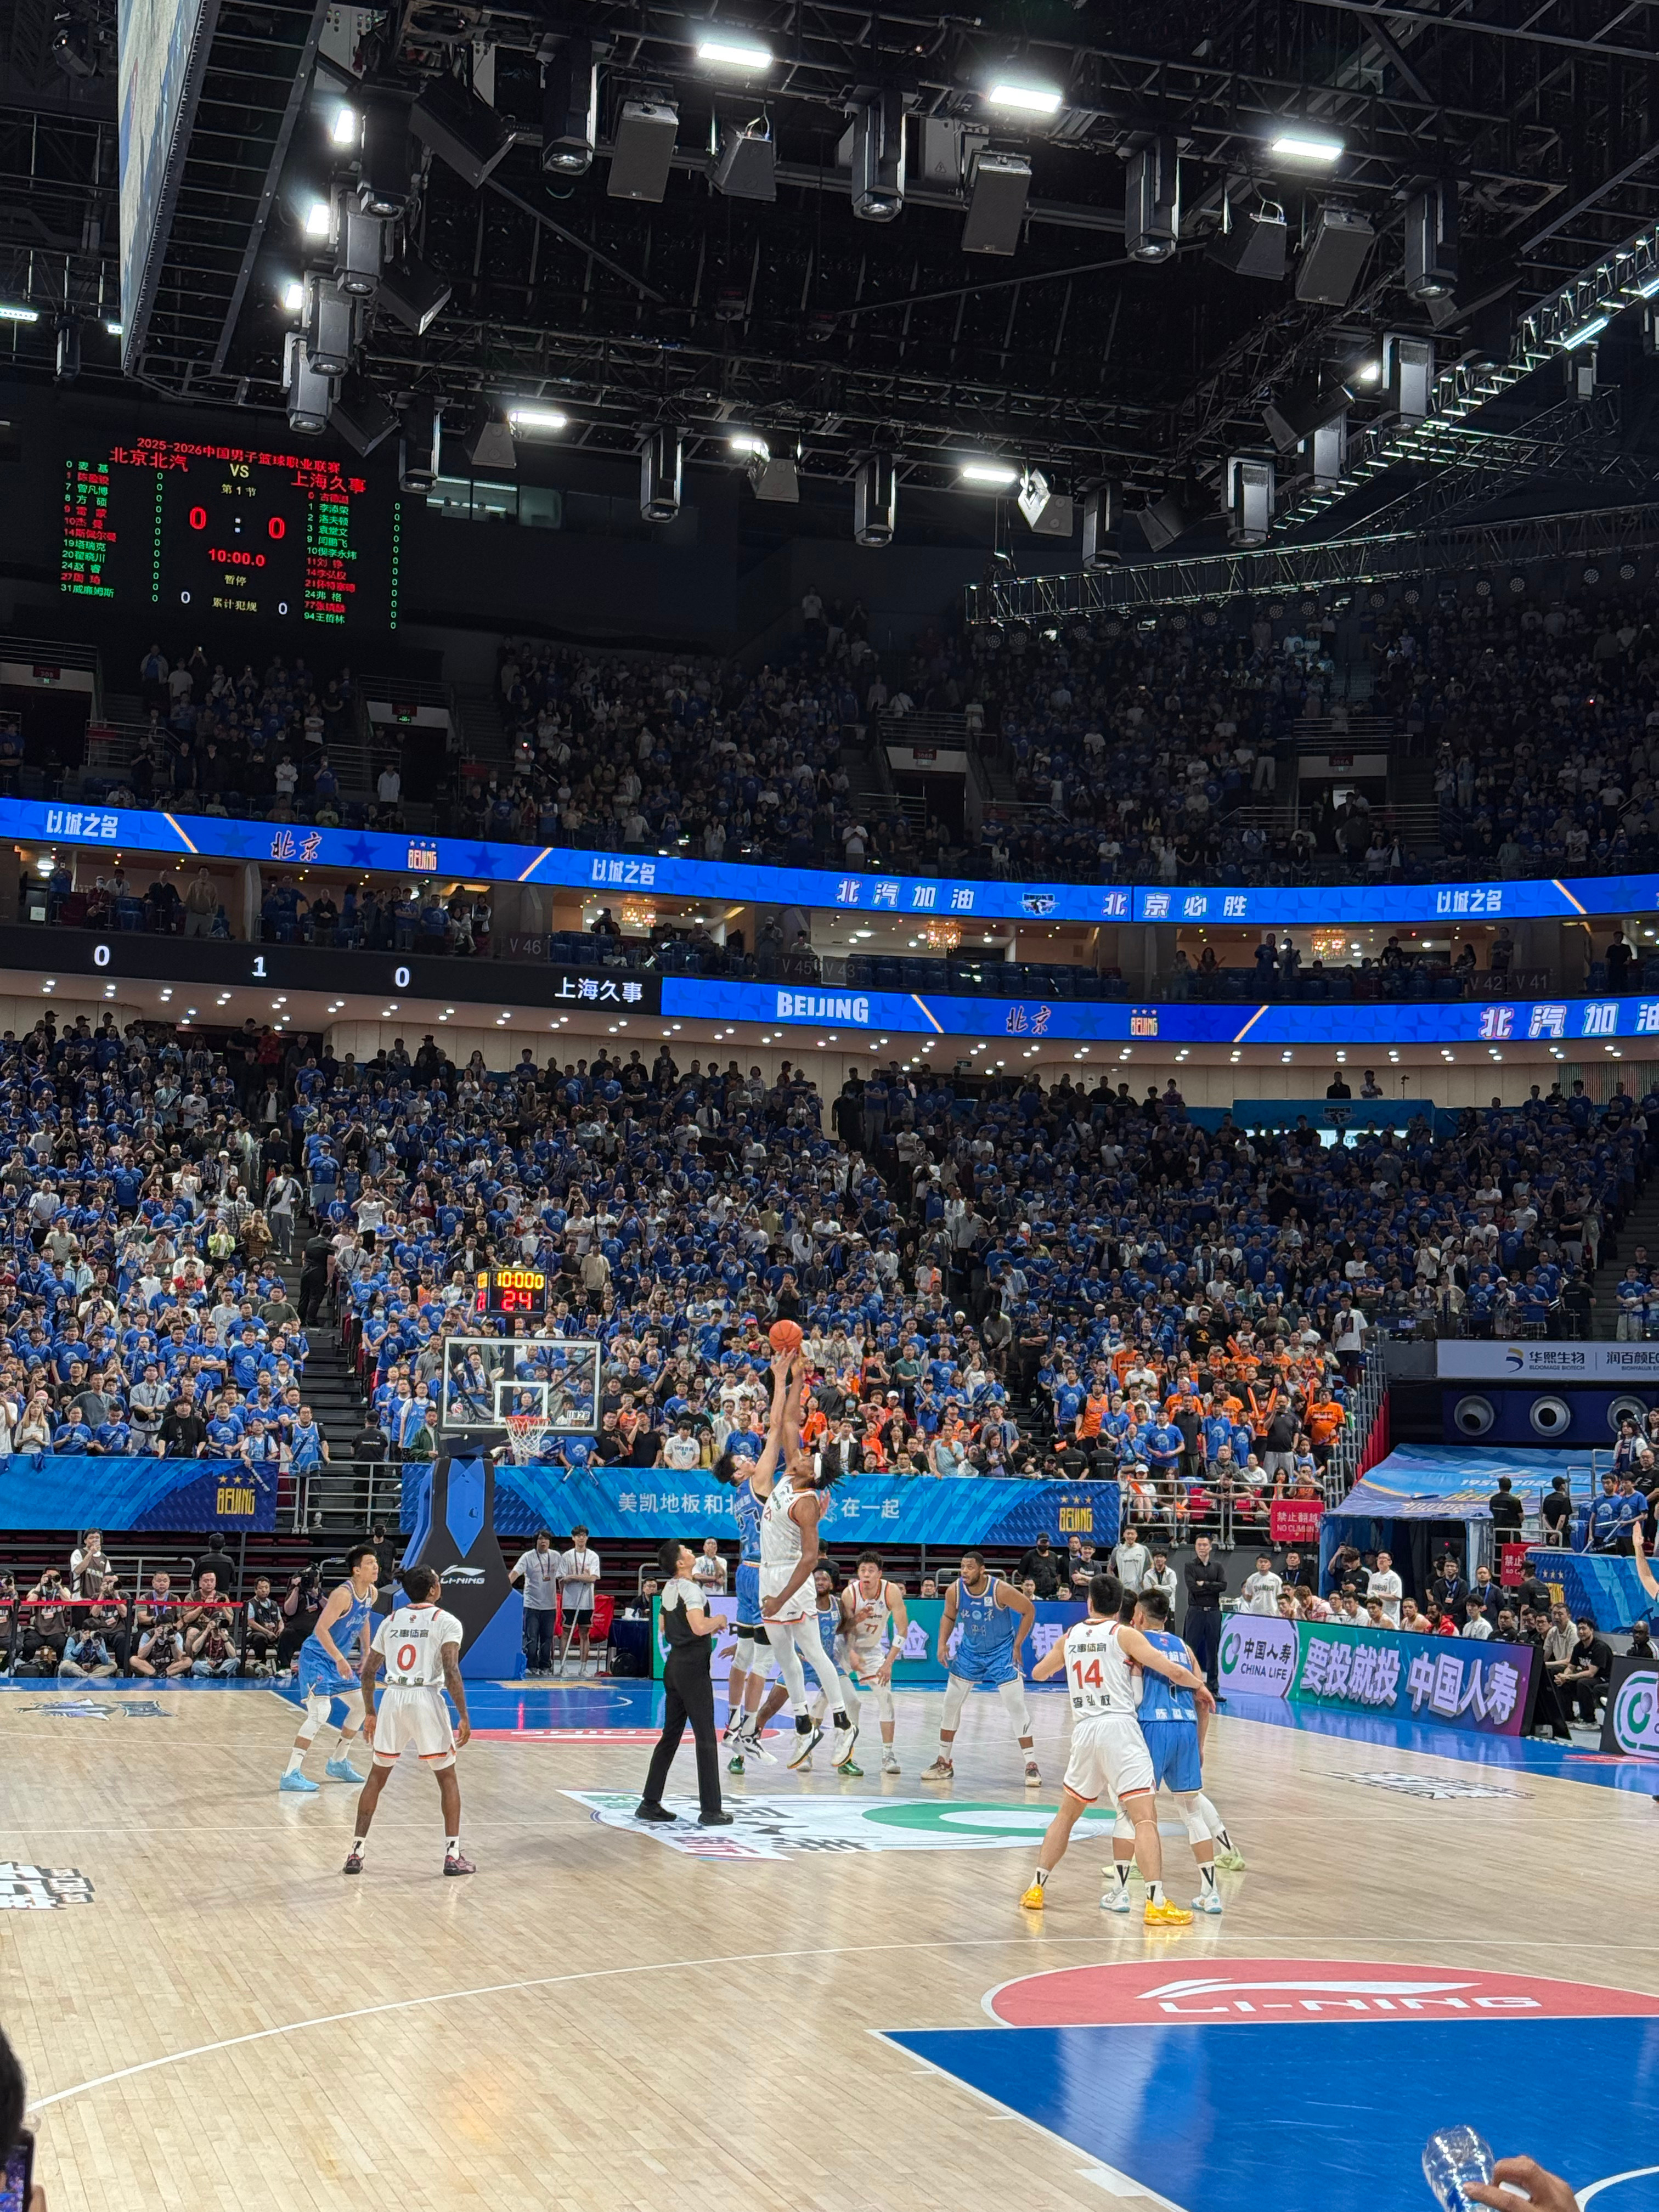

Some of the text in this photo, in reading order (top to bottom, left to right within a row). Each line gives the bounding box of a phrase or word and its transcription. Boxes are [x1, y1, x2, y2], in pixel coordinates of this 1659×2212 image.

[109, 447, 188, 472] 北京北汽
[137, 438, 340, 473] 2025-2026中国男子篮球职业联赛
[230, 464, 249, 478] VS
[291, 471, 366, 494] 上海久事
[189, 506, 207, 529] 0
[268, 517, 286, 539] 0
[208, 549, 265, 567] 10:00.0
[225, 575, 247, 586] 暂停
[181, 591, 190, 603] 0
[212, 597, 257, 612] 累计犯规
[279, 603, 287, 614] 0
[46, 809, 119, 839] 以城之名
[271, 831, 323, 861] 北京
[408, 848, 437, 871] BEIJING
[592, 857, 656, 885] 以城之名
[836, 880, 974, 910] 北汽加油
[1102, 891, 1247, 918] 北京必胜
[1436, 890, 1502, 913] 以城之名
[94, 945, 110, 967] 0
[510, 938, 541, 955] V 46
[252, 957, 267, 977] 1
[782, 958, 812, 975] V 45
[838, 963, 855, 978] 43
[395, 967, 410, 988] 0
[1470, 976, 1503, 991] V 42
[1515, 975, 1548, 989] V 41
[554, 977, 643, 1003] 上海久事
[776, 991, 869, 1024] BEIJING
[1006, 1006, 1051, 1035] 北京
[1130, 1017, 1158, 1036] BEIJING
[1480, 1005, 1659, 1039] 北汽加油
[501, 1290, 533, 1311] 24
[1529, 1351, 1585, 1365] 华熙生物
[217, 1487, 256, 1515] BEIJING
[840, 1498, 900, 1519] 在一起
[1059, 1507, 1092, 1532] BEIJING
[1277, 1511, 1318, 1523] 禁止翻越
[1504, 1555, 1523, 1567] 禁止
[441, 1576, 485, 1584] LI-NING
[390, 1629, 430, 1638] 久事体育
[397, 1644, 416, 1671] 0
[1068, 1643, 1107, 1654] 久事体育
[1243, 1637, 1292, 1664] 中国人寿
[1072, 1659, 1103, 1689] 14
[1240, 1663, 1287, 1680] CHINA LIFE
[1300, 1637, 1520, 1725] 要投就投 中国人寿
[1160, 1996, 1542, 2013] LI-NING
